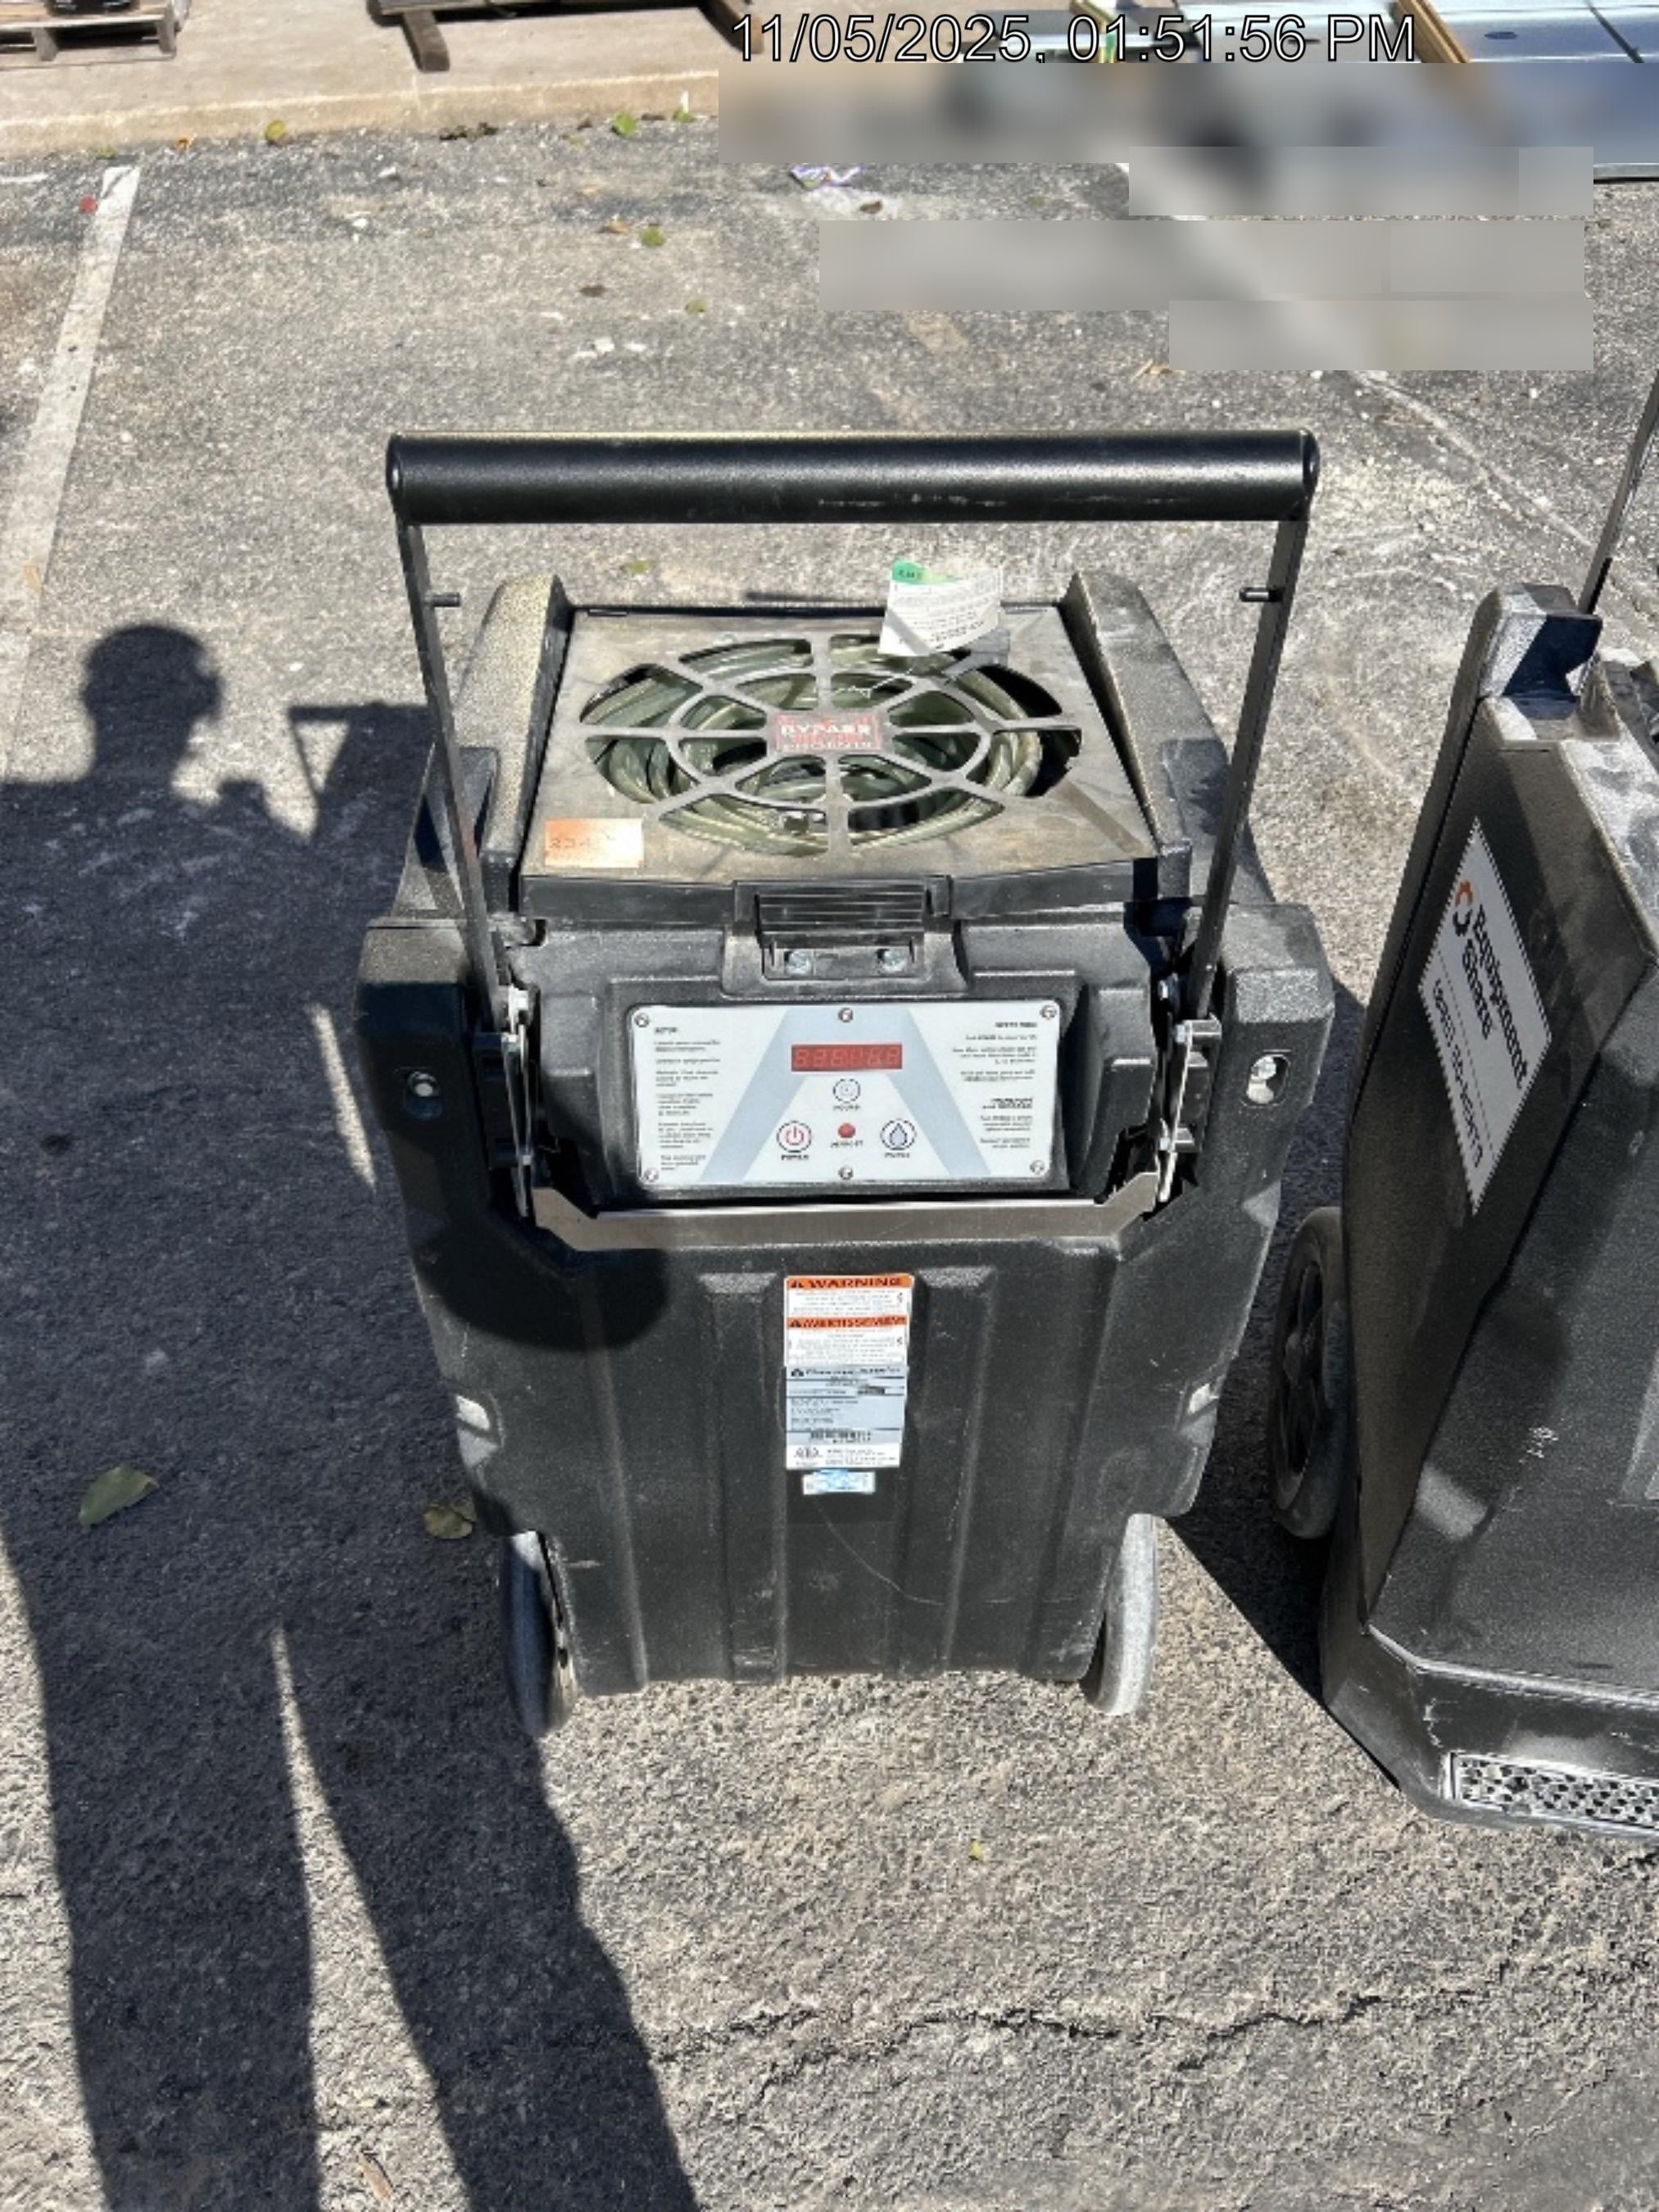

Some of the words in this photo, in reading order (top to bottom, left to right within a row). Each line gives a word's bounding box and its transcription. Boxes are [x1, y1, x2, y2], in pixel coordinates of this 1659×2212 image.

[1462, 937, 1493, 1040] Share
[1473, 903, 1527, 1090] Equipment
[808, 1276, 902, 1290] WARNING
